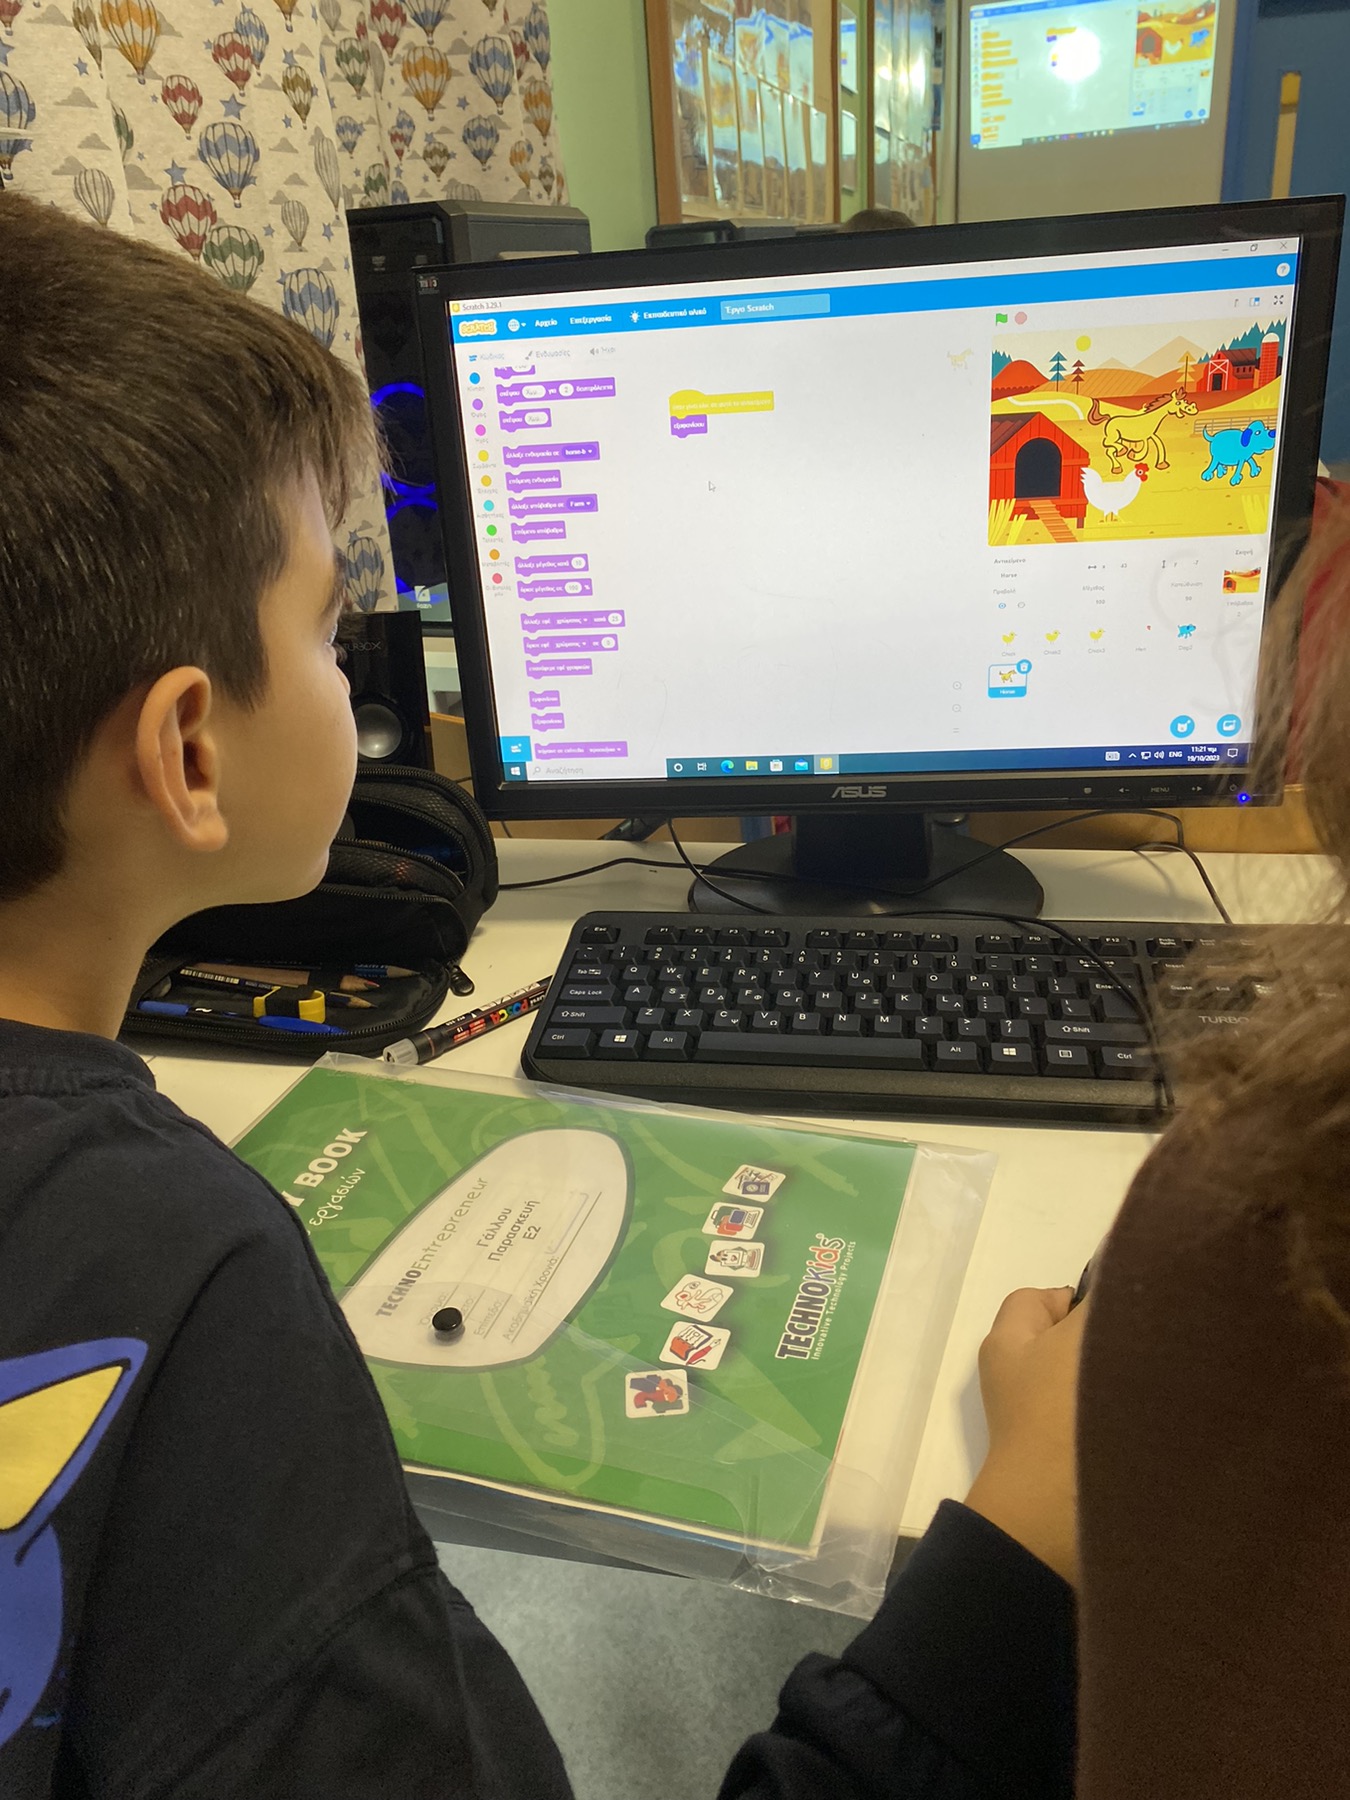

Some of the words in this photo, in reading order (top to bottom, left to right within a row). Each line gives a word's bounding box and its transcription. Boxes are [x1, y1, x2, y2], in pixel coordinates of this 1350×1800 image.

[462, 303, 485, 311] Scratch
[725, 305, 745, 316] Έργο
[747, 303, 774, 312] Scratch
[460, 320, 496, 335] SCRATCH
[535, 319, 558, 328] Αρχείο
[831, 785, 887, 798] ASUS
[569, 989, 586, 997] Caps
[490, 998, 529, 1025] POSCA
[552, 1033, 565, 1041] Ctrl
[293, 1127, 368, 1188] BOOK
[309, 1167, 366, 1226] εργασιών
[476, 1207, 512, 1248] Γάλλου
[487, 1200, 541, 1262] Παρασκευή
[775, 1236, 846, 1360] TECHNOKids
[811, 1316, 832, 1360] Innovative
[825, 1273, 848, 1315] Technology
[840, 1241, 856, 1271] Projects
